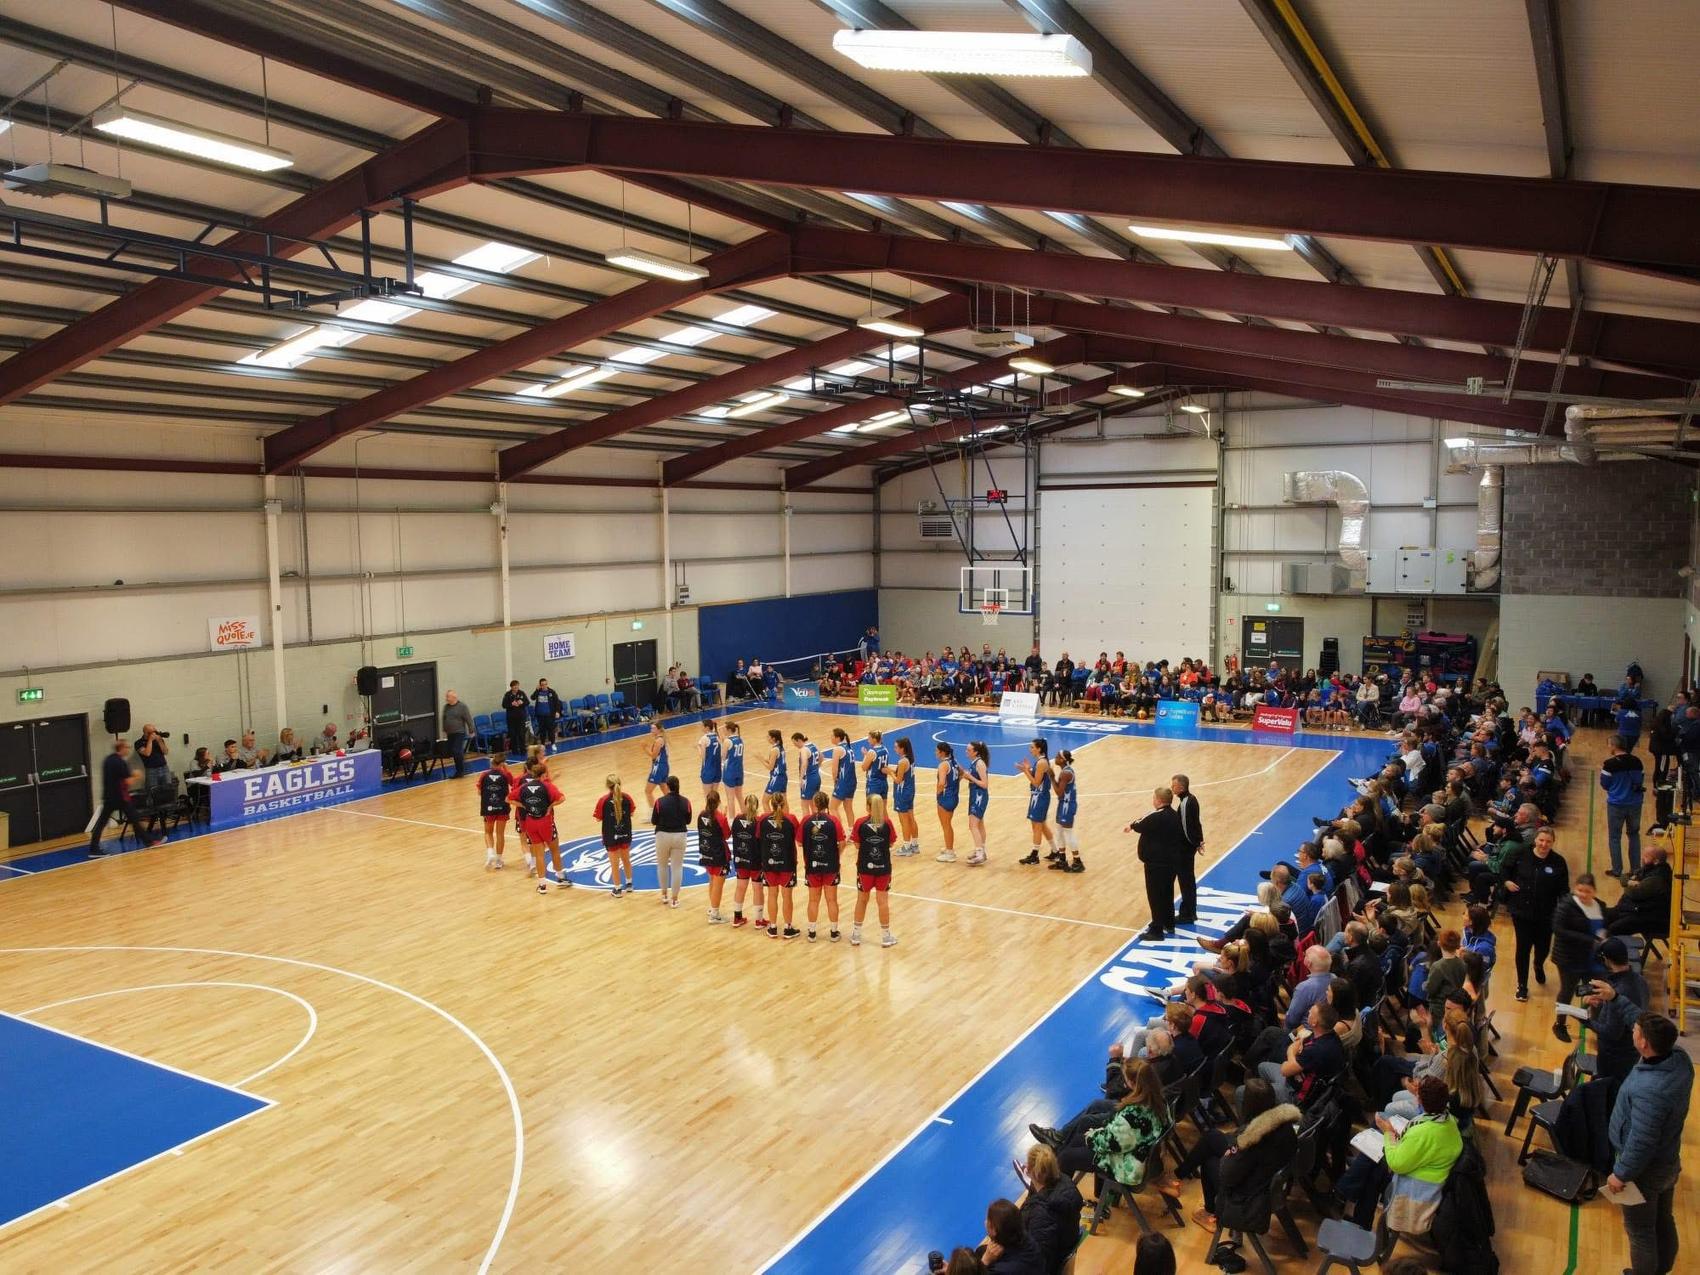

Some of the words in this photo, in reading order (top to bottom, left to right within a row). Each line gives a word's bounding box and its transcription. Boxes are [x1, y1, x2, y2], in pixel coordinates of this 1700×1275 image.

[548, 641, 570, 650] HOME
[548, 649, 571, 658] TEAM
[938, 712, 1130, 732] EAGLES
[1257, 716, 1292, 726] SuperValu
[712, 741, 719, 755] 7
[734, 744, 743, 757] 10
[812, 751, 820, 765] 12
[878, 754, 888, 769] 14
[244, 759, 355, 801] EAGLES
[243, 785, 355, 816] BASKETBALL
